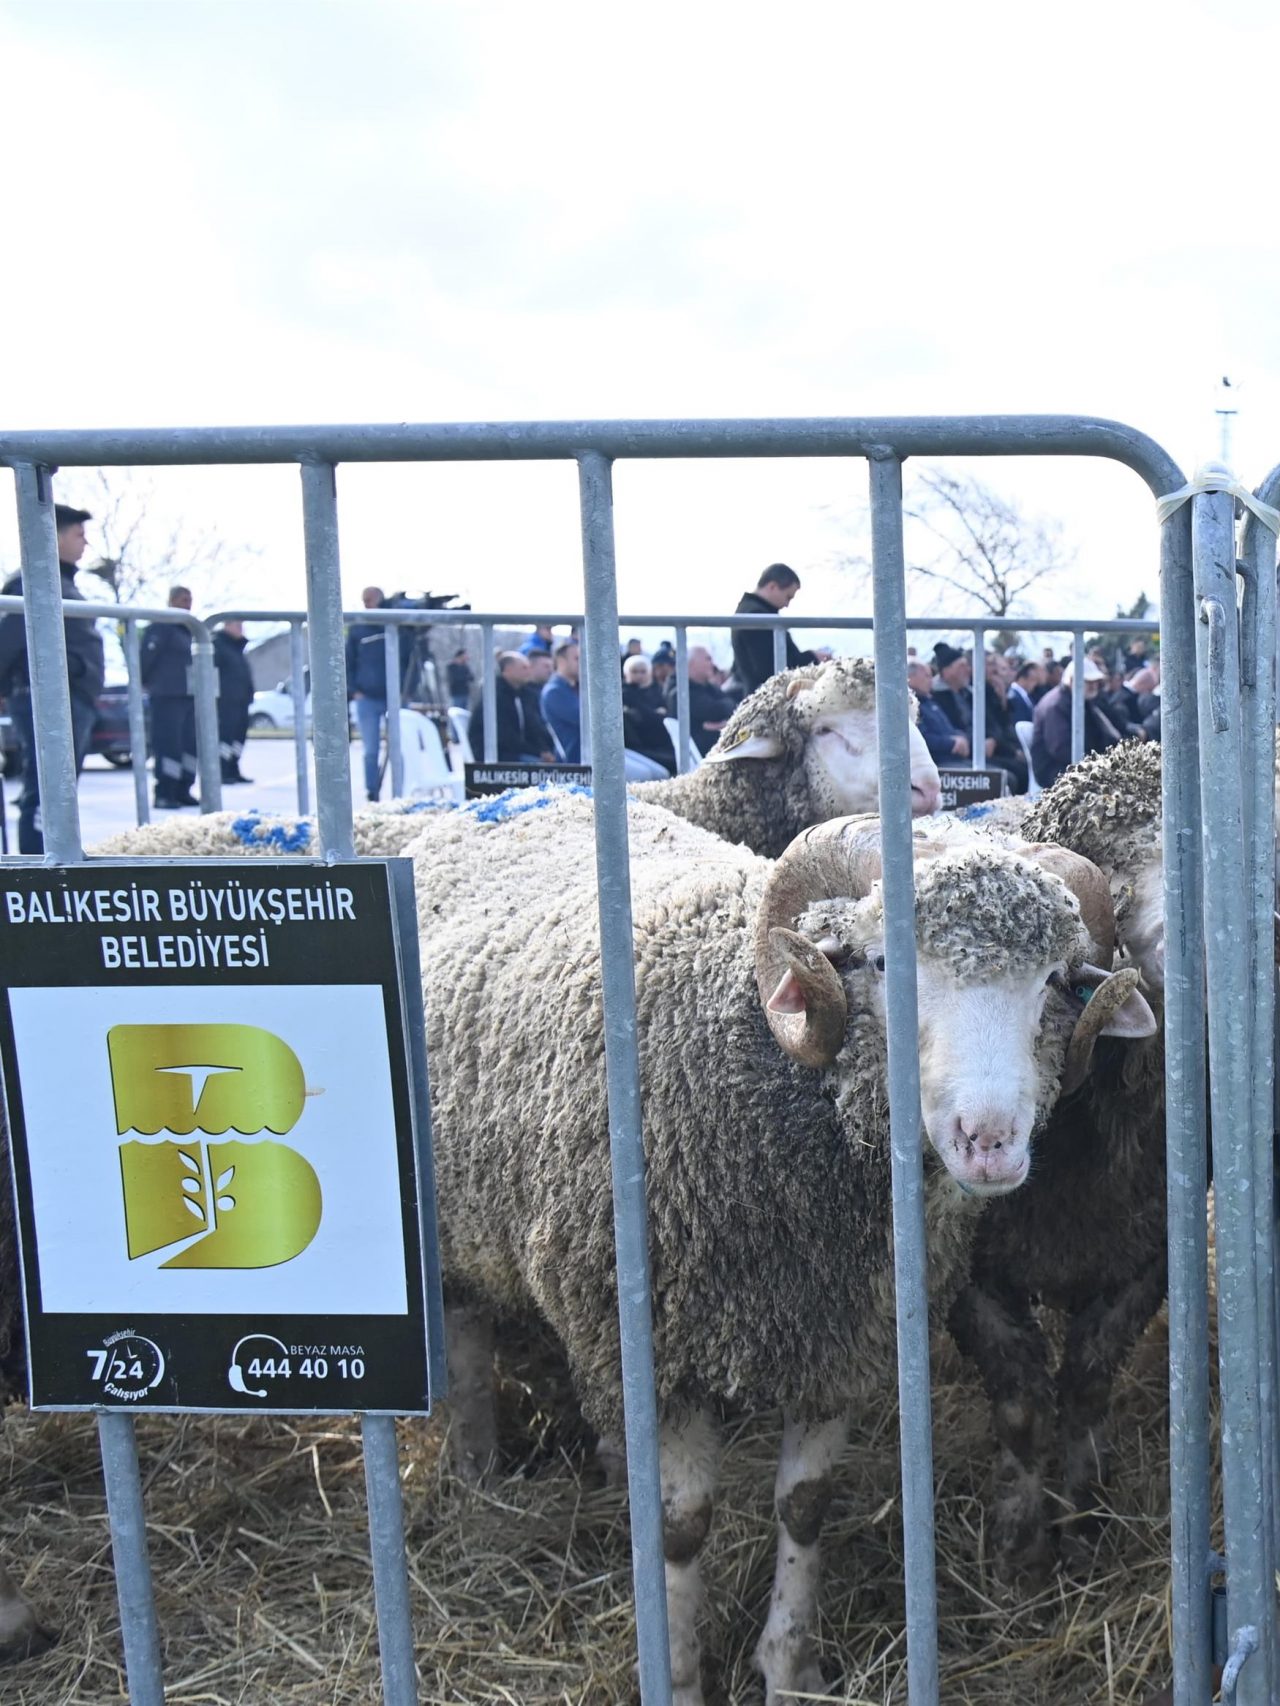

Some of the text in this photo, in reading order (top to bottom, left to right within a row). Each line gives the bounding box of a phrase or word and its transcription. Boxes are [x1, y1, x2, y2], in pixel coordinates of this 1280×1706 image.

[5, 881, 357, 925] BALIKESİR BÜYÜKŞEHİR
[101, 928, 270, 968] BELEDİYESİ
[290, 1345, 365, 1356] BEYAZ MASA
[248, 1358, 365, 1379] 444 40 10
